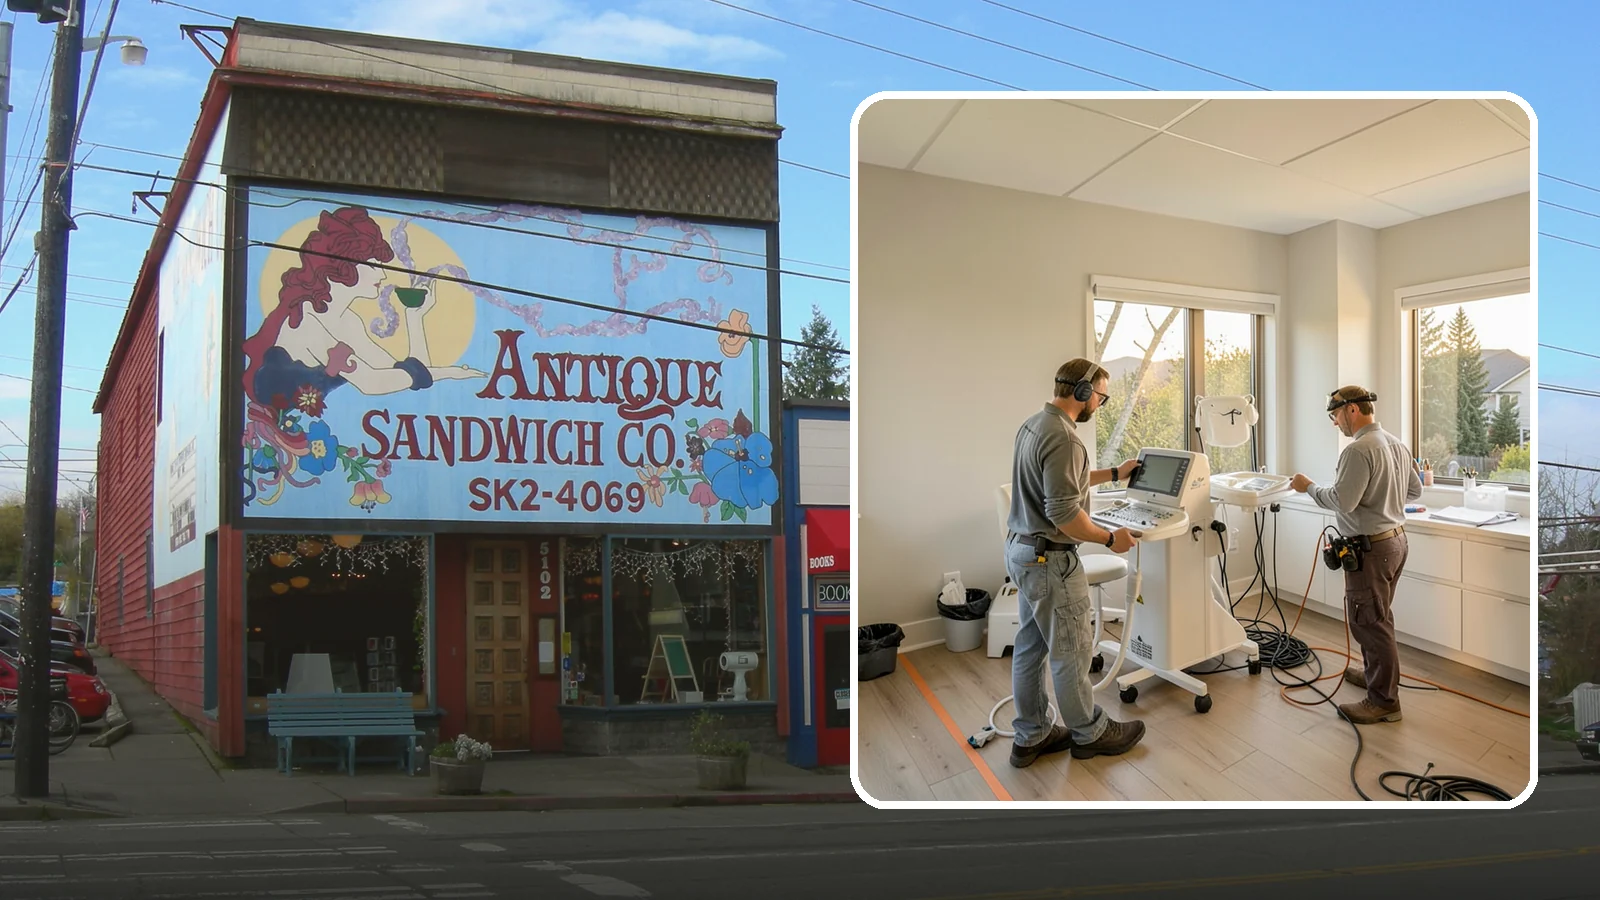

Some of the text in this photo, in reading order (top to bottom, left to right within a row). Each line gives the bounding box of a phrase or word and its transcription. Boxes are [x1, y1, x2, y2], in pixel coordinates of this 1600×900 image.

[476, 329, 723, 421] ANTIQUE
[361, 409, 684, 469] SANDWICH CO.
[468, 477, 645, 513] SK2-4069
[539, 541, 552, 600] 5102
[809, 554, 835, 569] BOOKS
